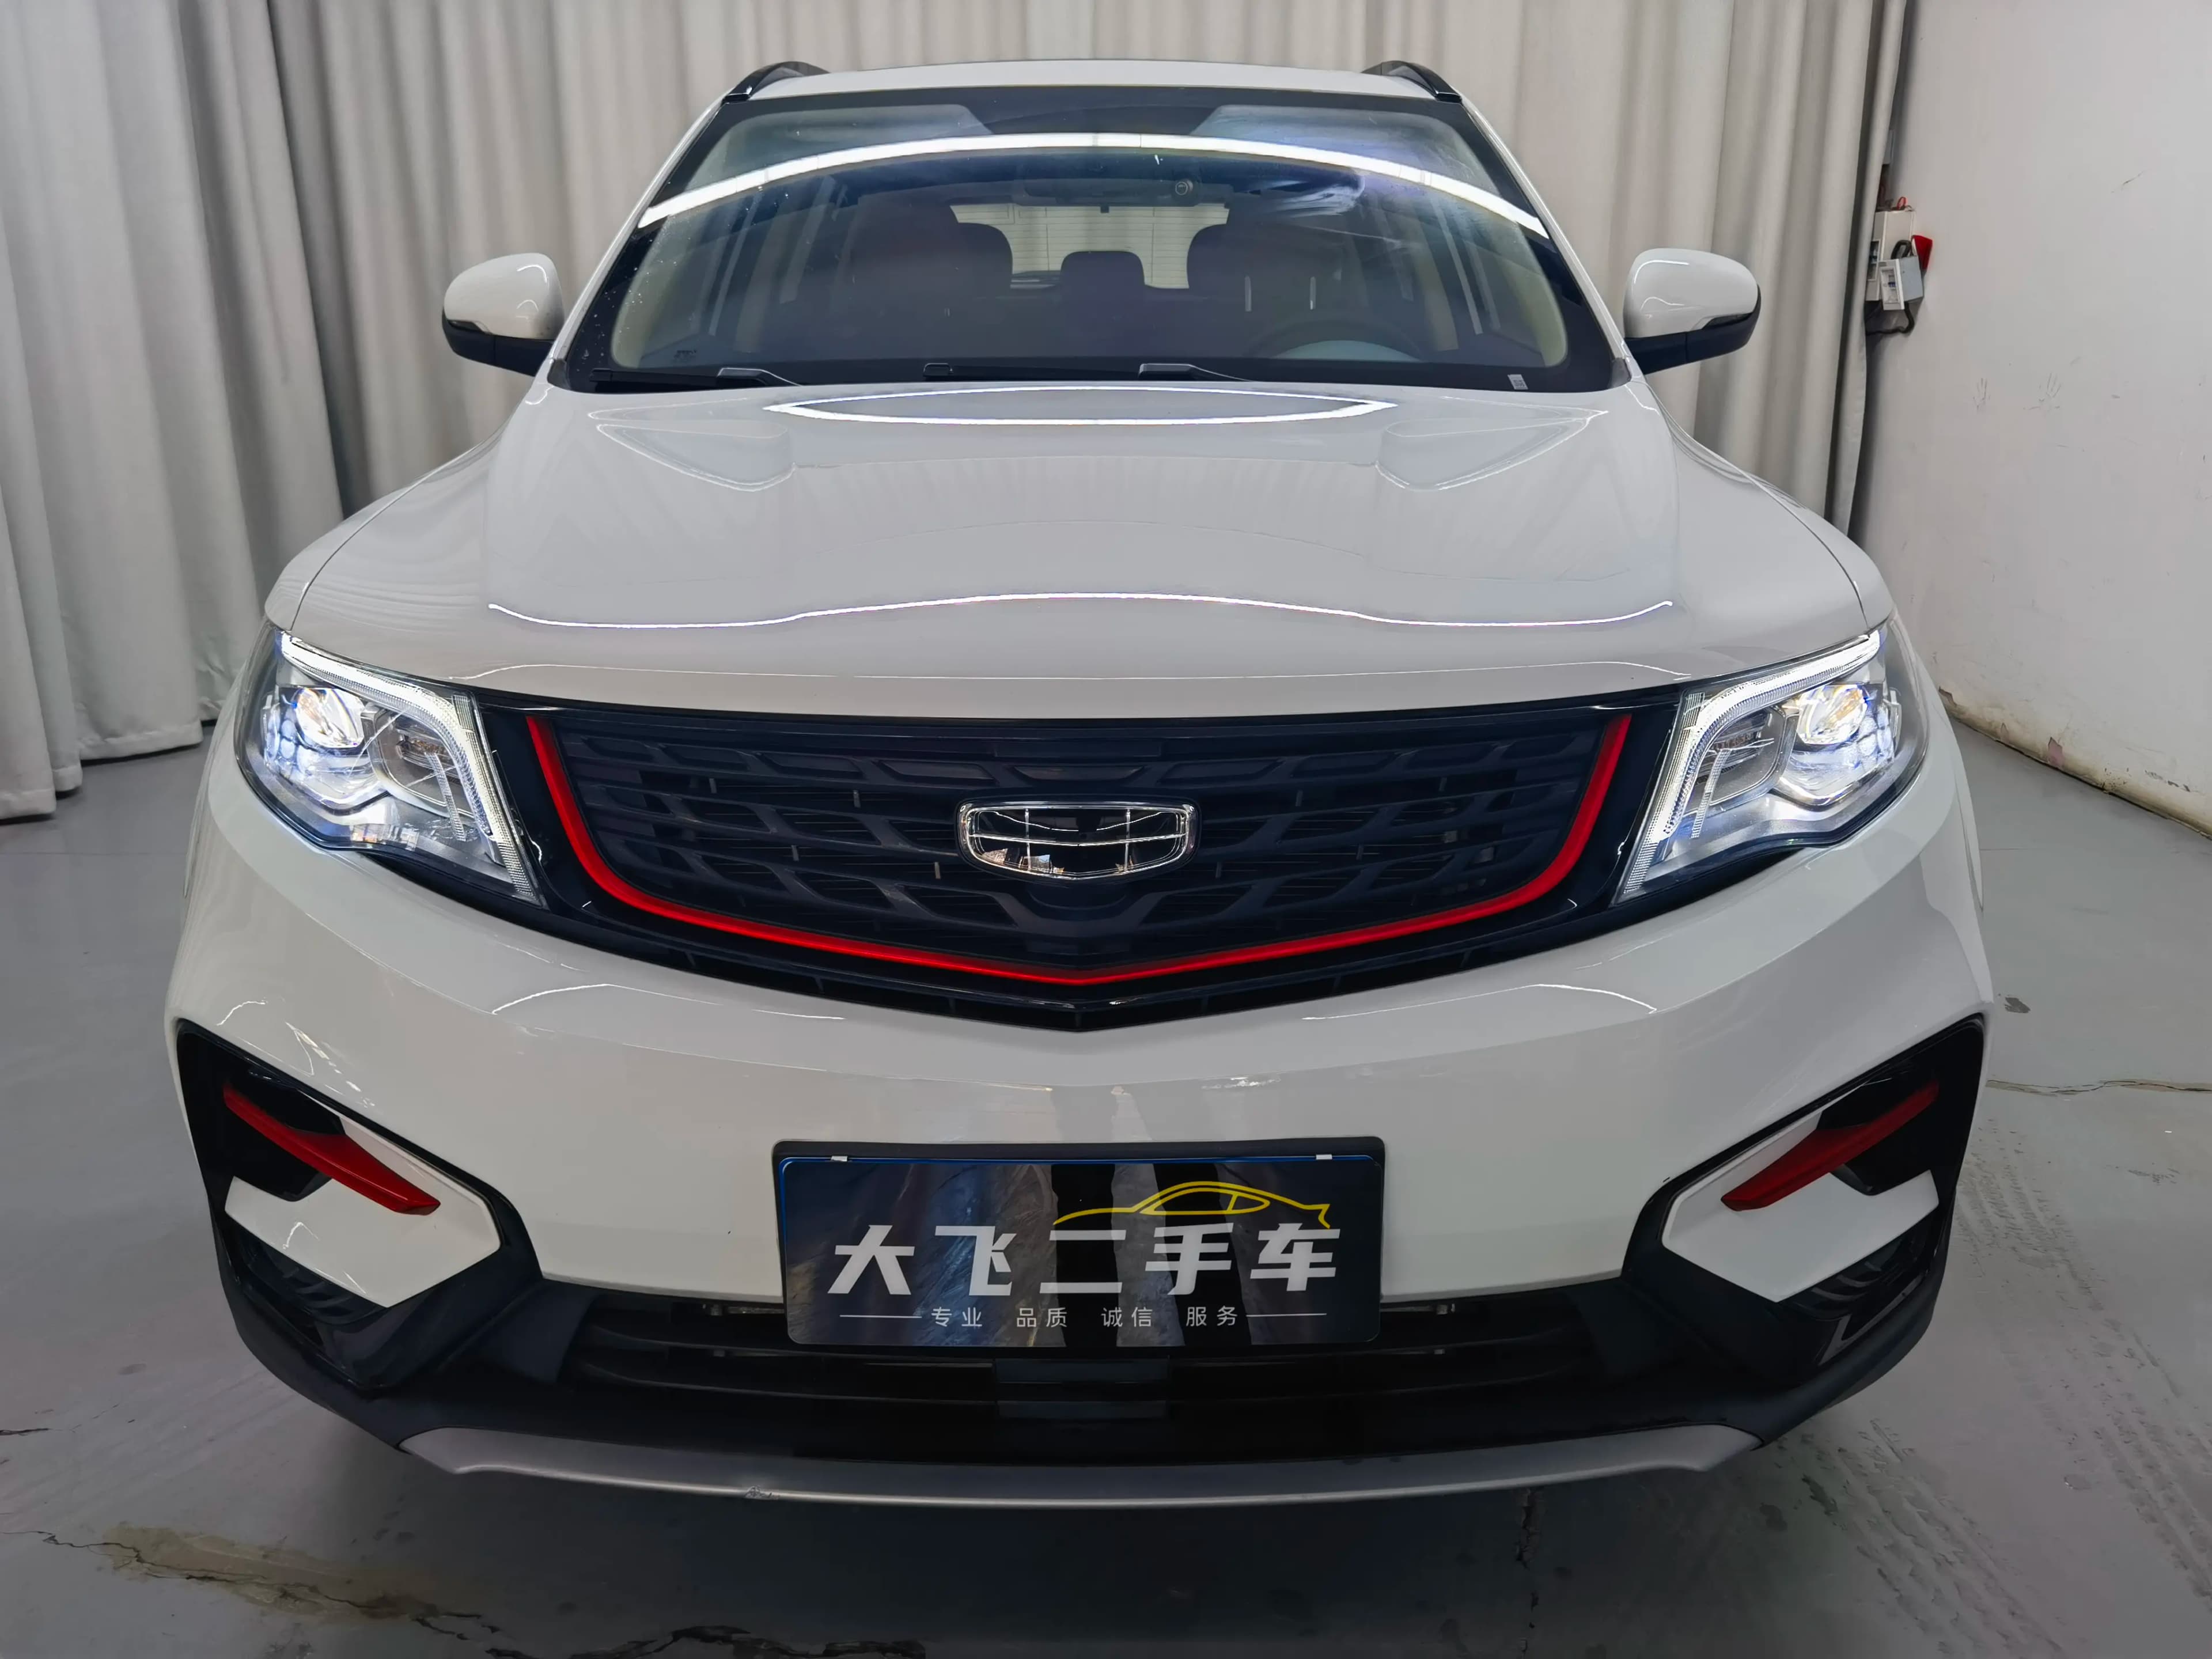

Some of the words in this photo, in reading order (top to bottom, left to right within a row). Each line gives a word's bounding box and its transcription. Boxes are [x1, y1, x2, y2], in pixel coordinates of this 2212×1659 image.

[827, 1222, 1340, 1296] 大飞二手车
[931, 1306, 983, 1327] 专业
[1016, 1307, 1067, 1328] 品质
[1101, 1306, 1153, 1328] 诚信
[1185, 1305, 1238, 1327] 服务
